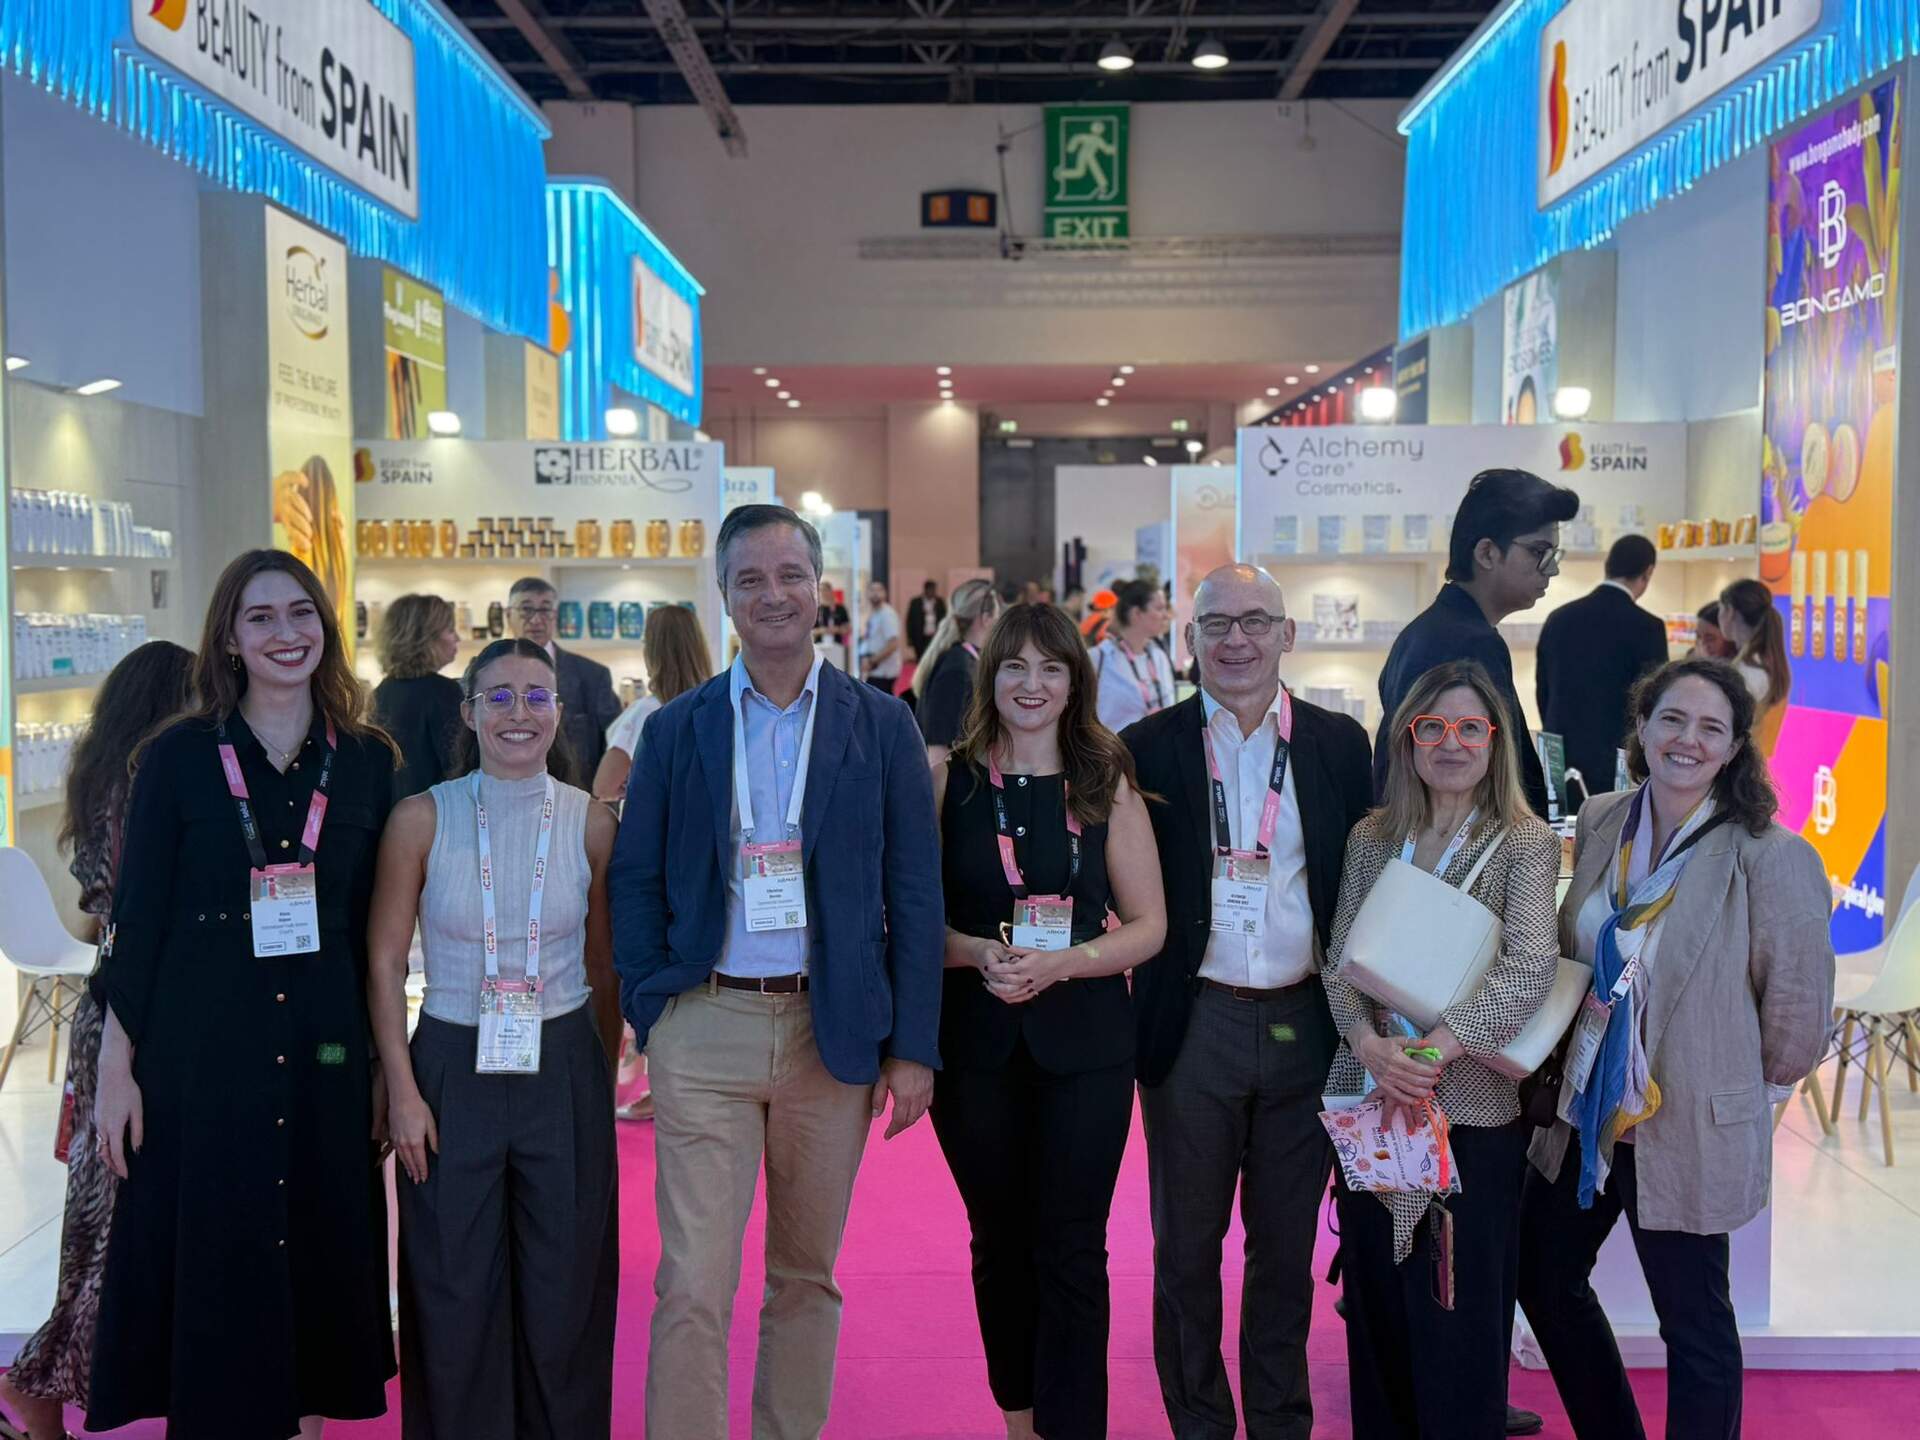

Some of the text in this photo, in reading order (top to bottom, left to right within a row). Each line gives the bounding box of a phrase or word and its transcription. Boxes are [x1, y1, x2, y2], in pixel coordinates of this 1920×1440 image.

[197, 0, 410, 190] BEAUTY from SPAIN
[1573, 57, 1628, 160] BEAUTY
[1631, 39, 1670, 121] from
[1053, 216, 1119, 240] EXIT
[286, 263, 329, 313] Herbal
[1780, 272, 1885, 327] BONGAMO
[575, 447, 701, 479] HERBAL
[1297, 436, 1425, 462] Alchemy
[1589, 455, 1648, 471] SPAIN
[380, 469, 433, 485] SPAIN
